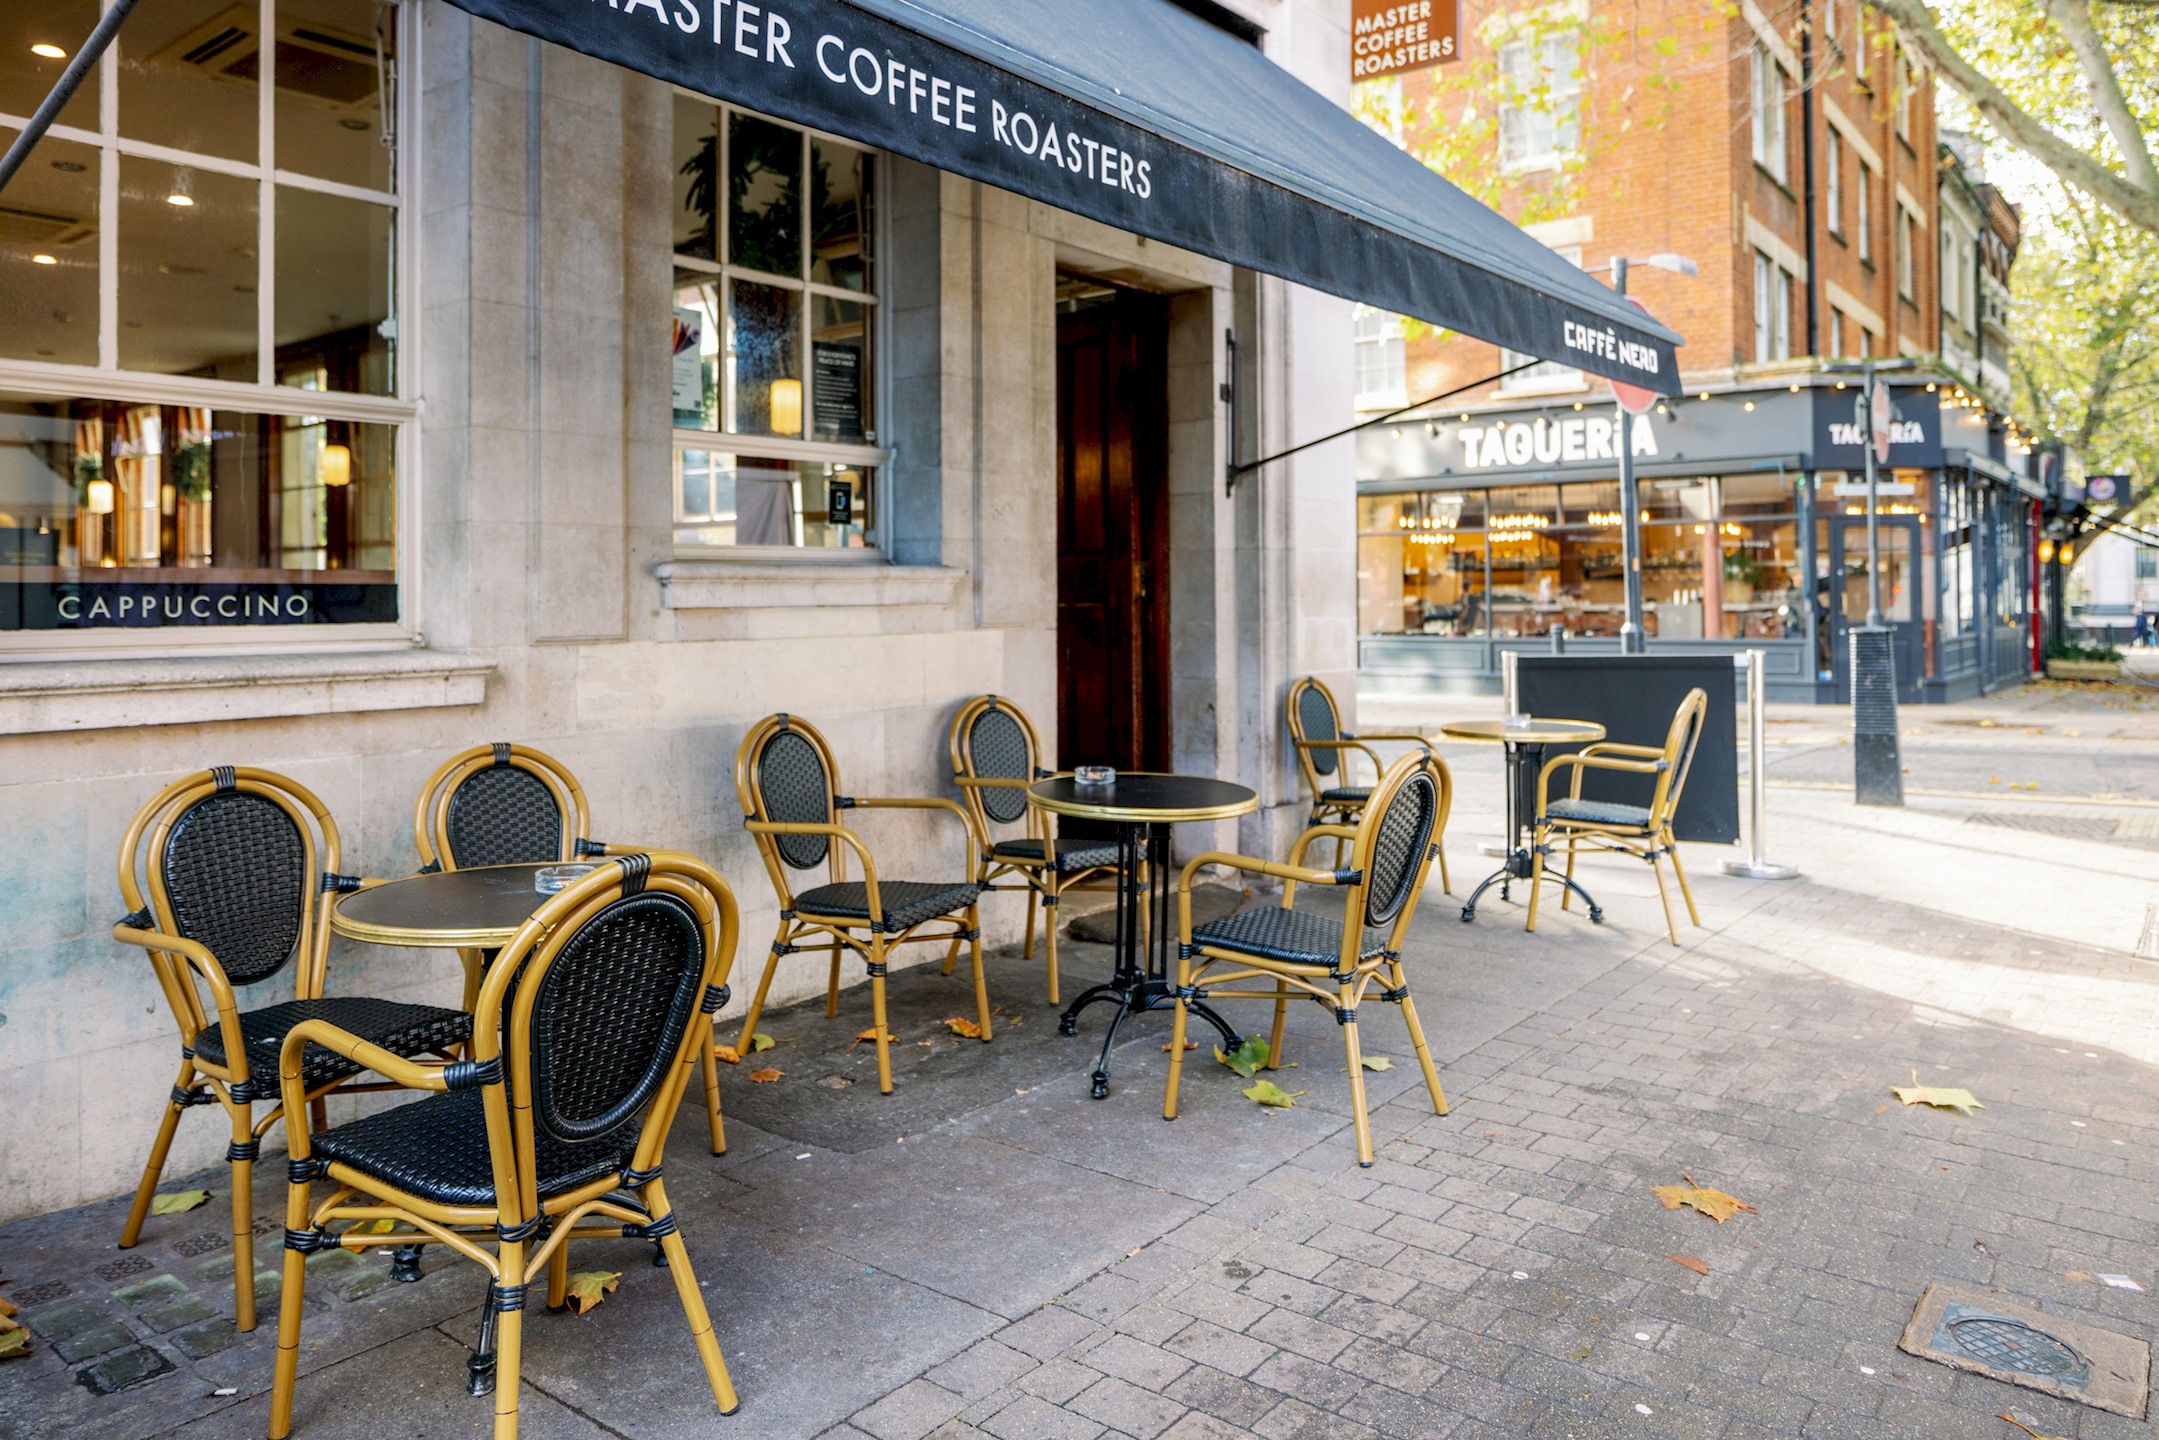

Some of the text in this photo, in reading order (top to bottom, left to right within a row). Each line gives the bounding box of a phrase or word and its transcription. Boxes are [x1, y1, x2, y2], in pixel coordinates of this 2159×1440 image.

[1354, 0, 1432, 36] MASTER
[1354, 21, 1429, 56] COFFEE
[1354, 35, 1454, 77] ROASTERS
[591, 0, 1152, 199] STER COFFEE ROASTERS
[1563, 320, 1659, 375] CAFFÈ NERO
[57, 594, 310, 620] CAPPUCCINO
